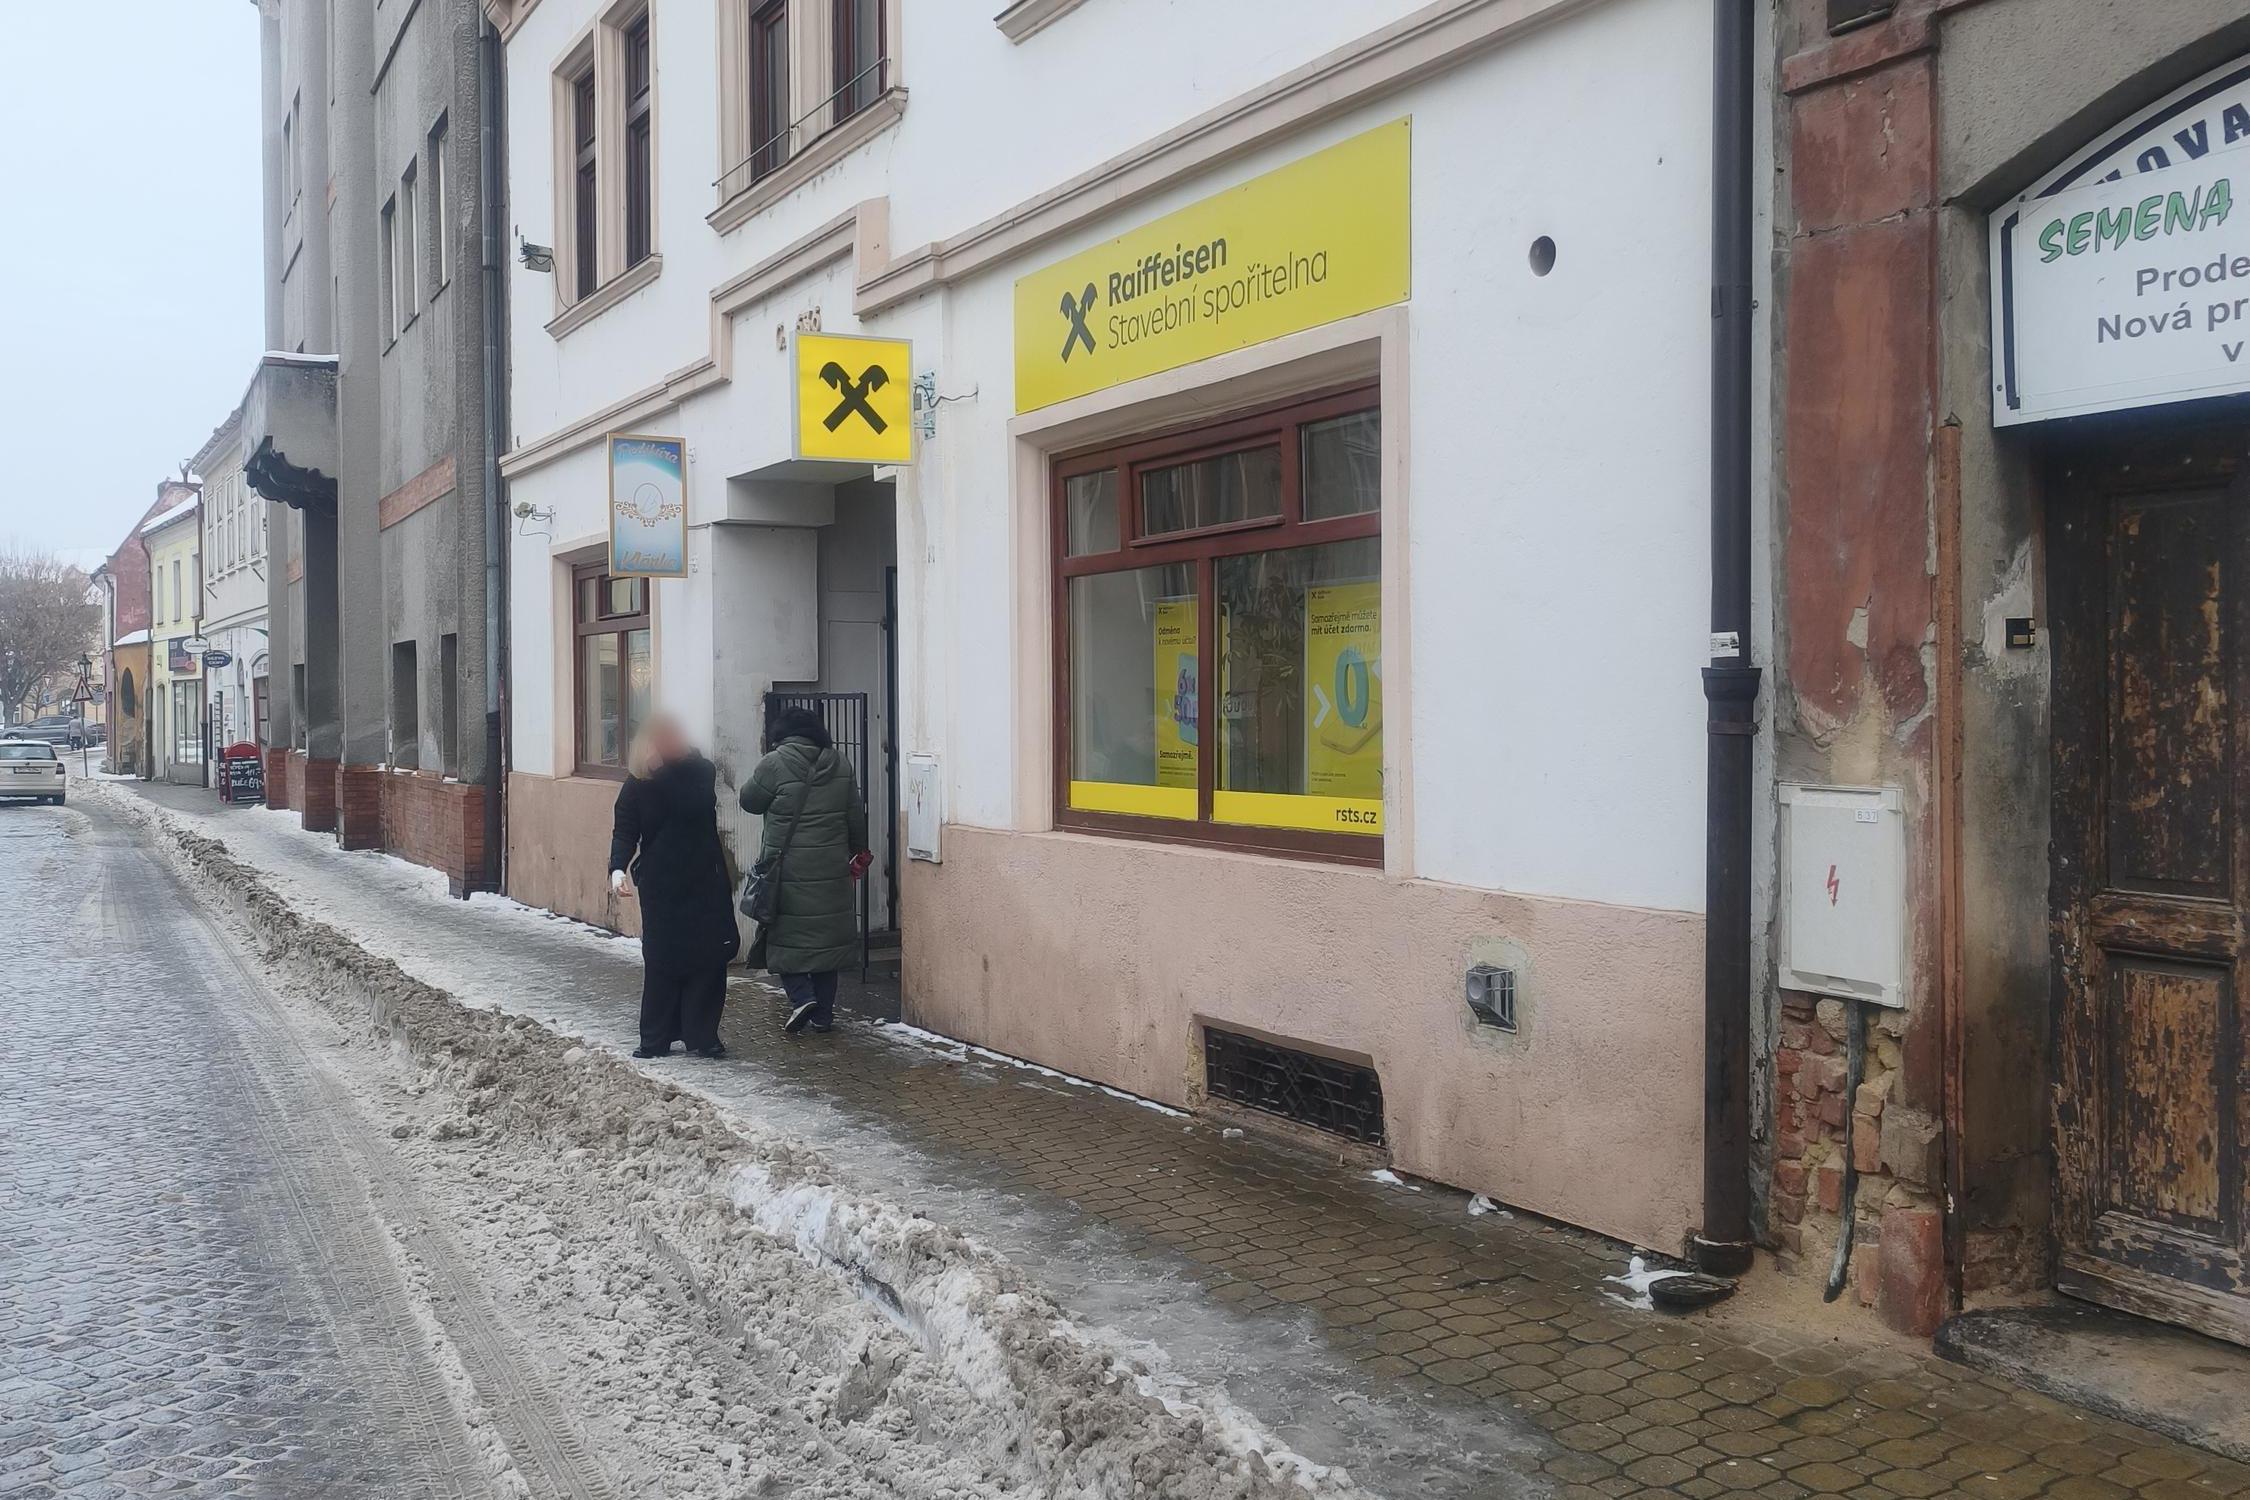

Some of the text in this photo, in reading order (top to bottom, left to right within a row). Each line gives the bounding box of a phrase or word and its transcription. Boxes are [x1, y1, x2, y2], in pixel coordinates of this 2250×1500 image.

[2039, 178, 2233, 263] SEMENA
[1108, 237, 1227, 307] Raiffeisen
[2136, 253, 2250, 296] Prode
[1108, 250, 1328, 349] Stavební spořitelna
[2097, 298, 2250, 344] Nová pr
[2221, 341, 2245, 363] v
[1311, 610, 1351, 624] Samozřejmě
[1324, 623, 1340, 635] účet
[1336, 807, 1377, 824] rsts.cz
